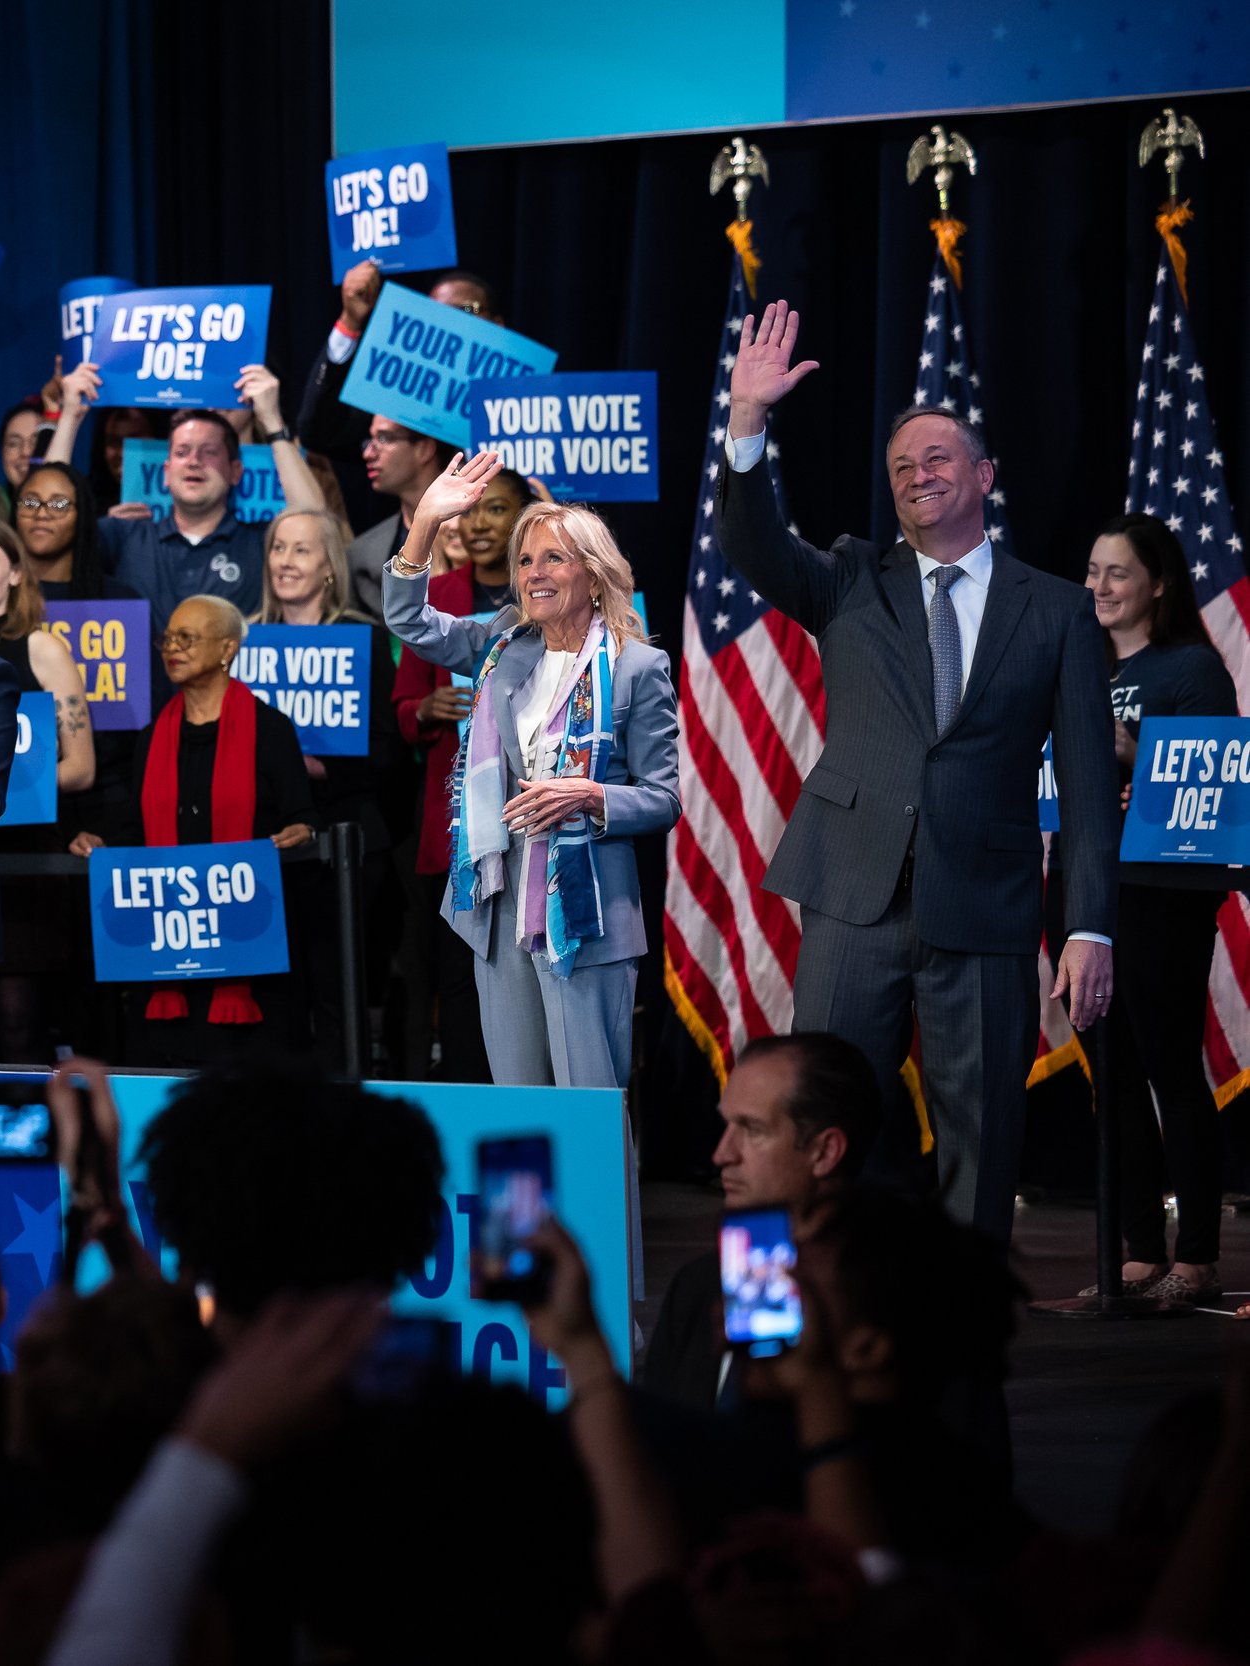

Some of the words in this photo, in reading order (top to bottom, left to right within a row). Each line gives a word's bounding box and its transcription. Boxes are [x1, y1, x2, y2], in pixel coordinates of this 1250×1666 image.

[333, 168, 385, 216] LET'S
[388, 162, 429, 205] GO
[352, 206, 400, 253] JOE!
[110, 303, 196, 342] LET'S
[200, 302, 246, 342] GO
[386, 311, 463, 368] YOUR
[136, 341, 207, 381] JOE!
[365, 347, 441, 404] YOUR
[484, 395, 562, 436] YOUR
[568, 394, 642, 432] VOTE
[561, 437, 650, 475] VOICE
[238, 468, 285, 501] OTE
[79, 619, 126, 660] GO
[284, 646, 354, 684] VOTE
[276, 689, 361, 728] VOICE
[1150, 739, 1218, 783] LET'S
[1165, 787, 1223, 830] JOE!
[112, 865, 200, 908] LET'S
[207, 862, 256, 904] GO
[150, 908, 221, 951] JOE!
